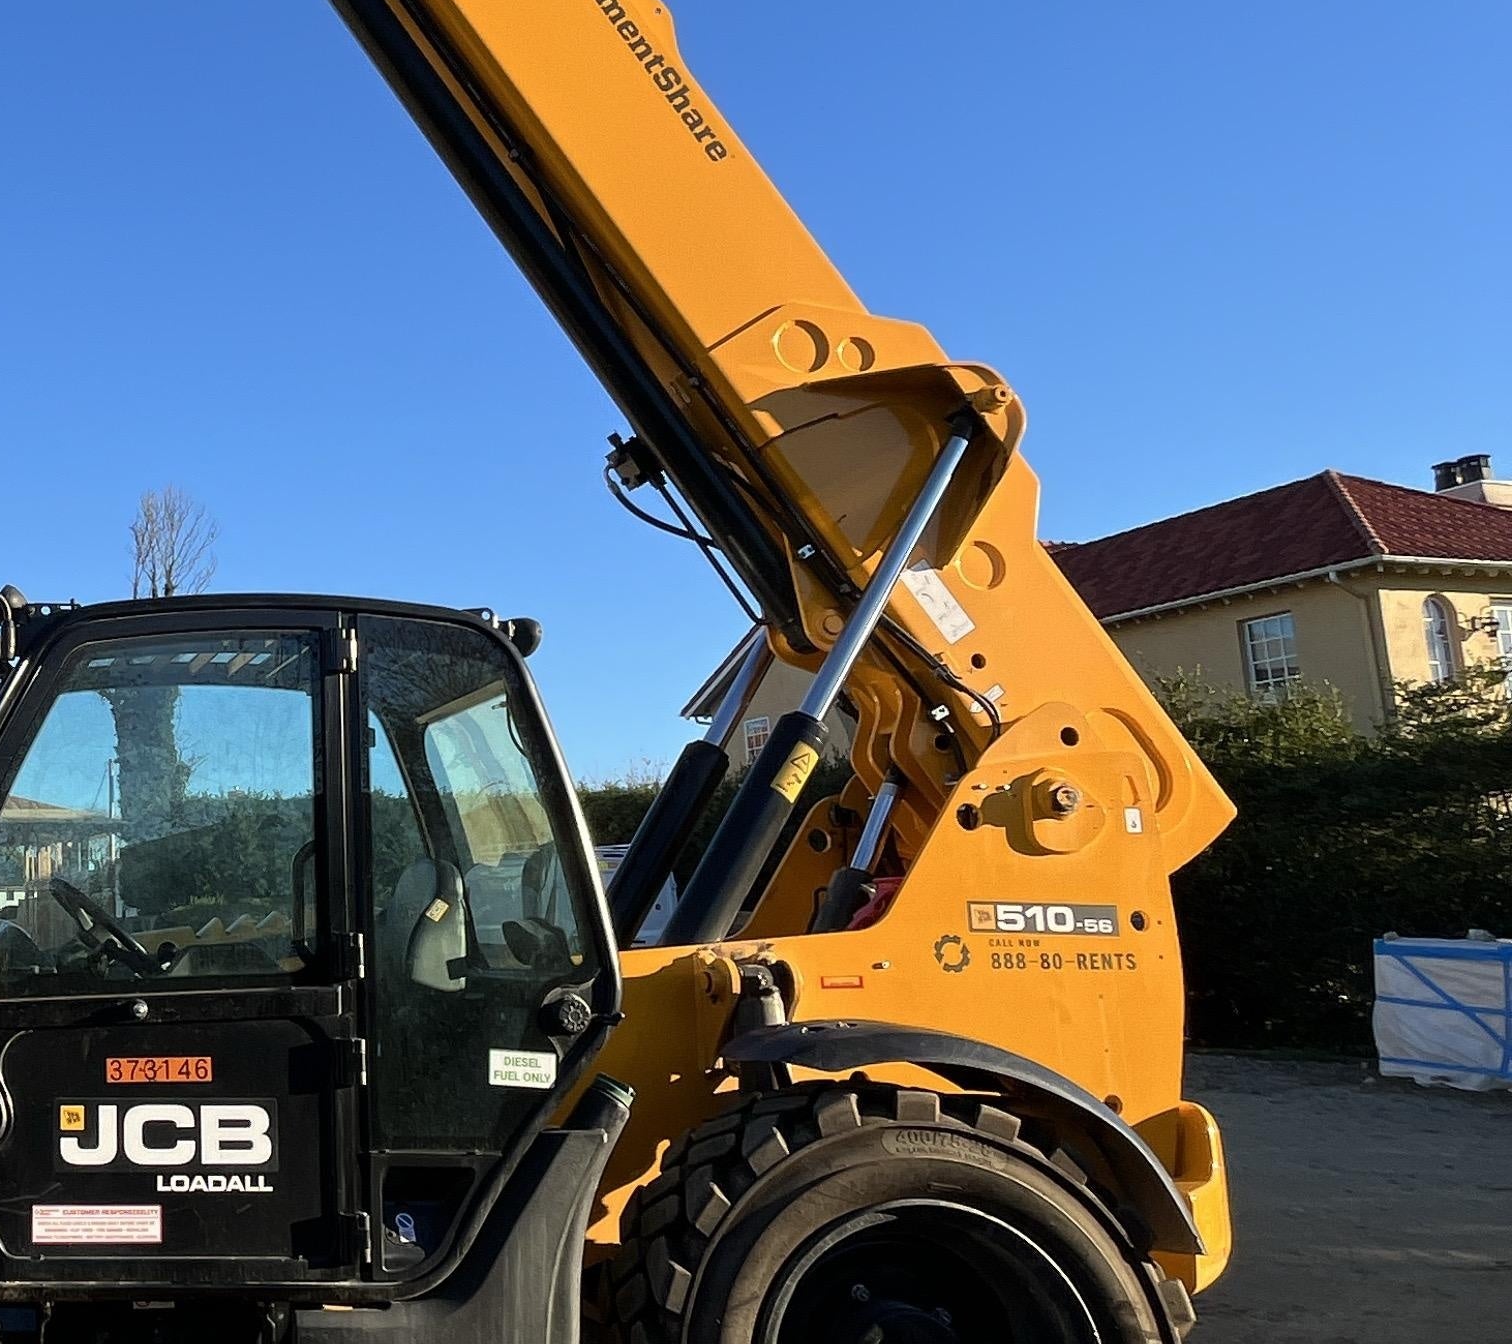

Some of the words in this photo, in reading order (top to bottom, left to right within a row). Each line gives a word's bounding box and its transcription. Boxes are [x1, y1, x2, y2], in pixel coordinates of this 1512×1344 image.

[995, 904, 1114, 934] 510-56
[988, 938, 1014, 948] CALL
[1018, 939, 1041, 948] NOW
[990, 952, 1138, 971] 888-80-RENTS
[109, 1058, 209, 1081] 373146
[503, 1056, 542, 1069] DIESEL
[493, 1069, 521, 1082] FUEL
[522, 1071, 552, 1084] ONLY
[59, 1104, 273, 1166] JCB
[156, 1174, 274, 1193] LOADALL
